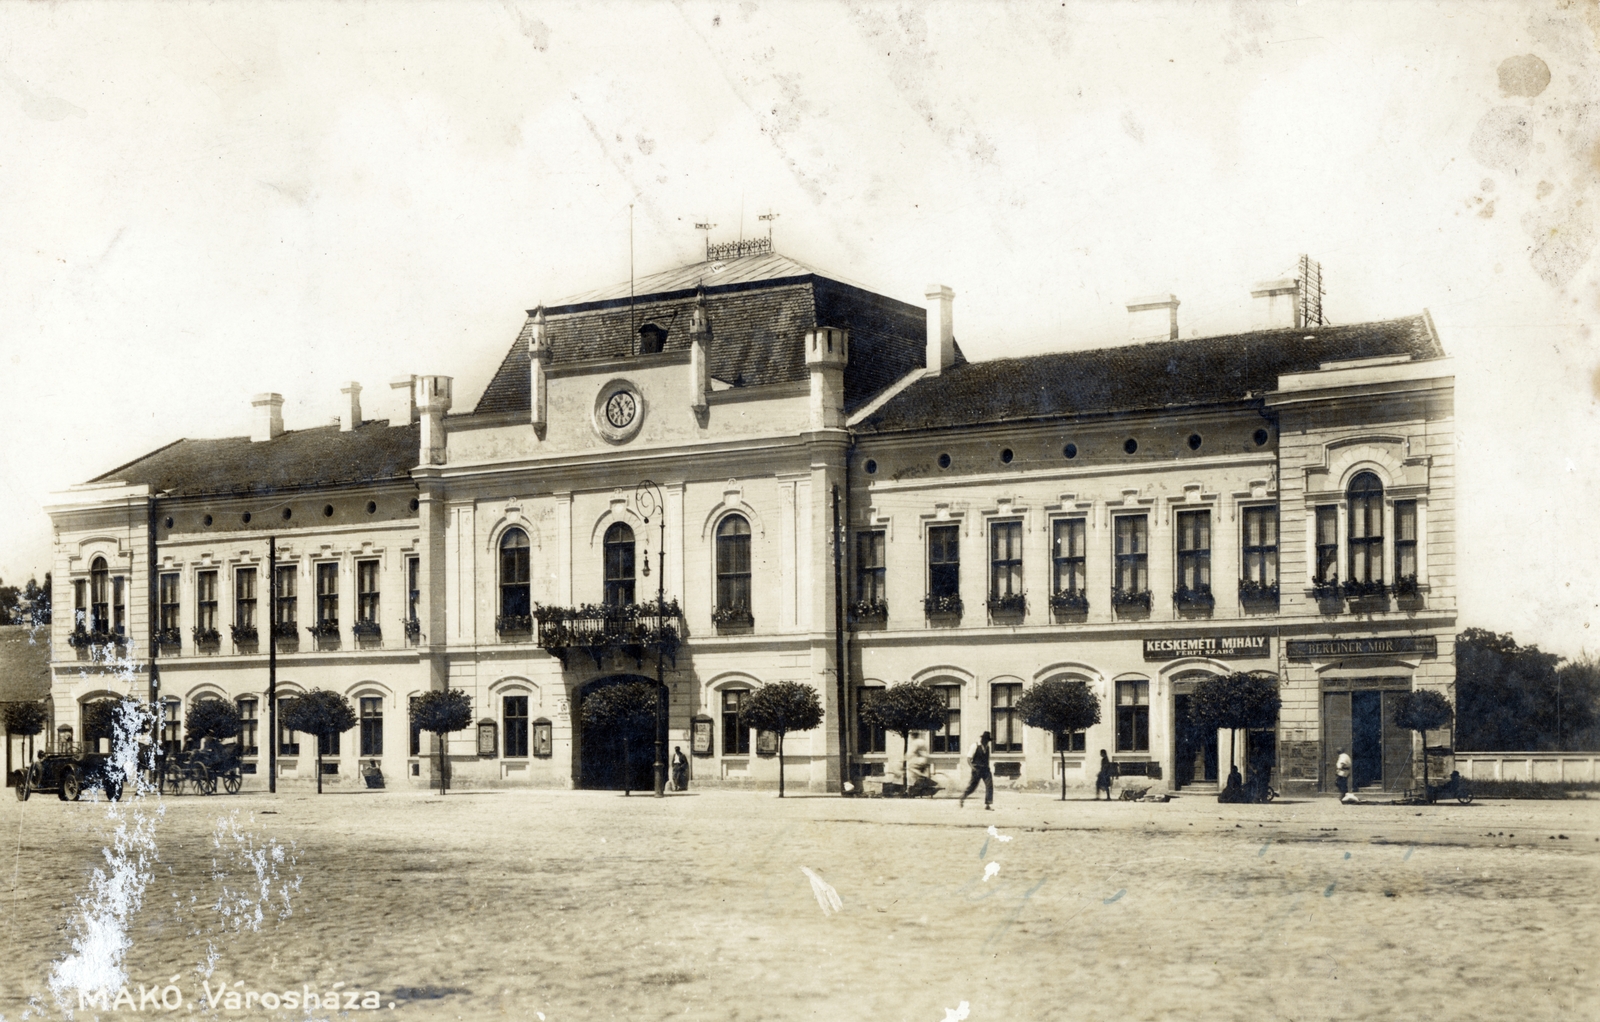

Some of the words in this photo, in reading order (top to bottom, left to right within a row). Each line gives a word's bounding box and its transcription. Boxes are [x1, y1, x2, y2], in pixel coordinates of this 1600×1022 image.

[1146, 637, 1216, 651] KECSKEMÉTI
[1221, 635, 1265, 649] MIHÁLY
[1308, 642, 1363, 654] BERLINER
